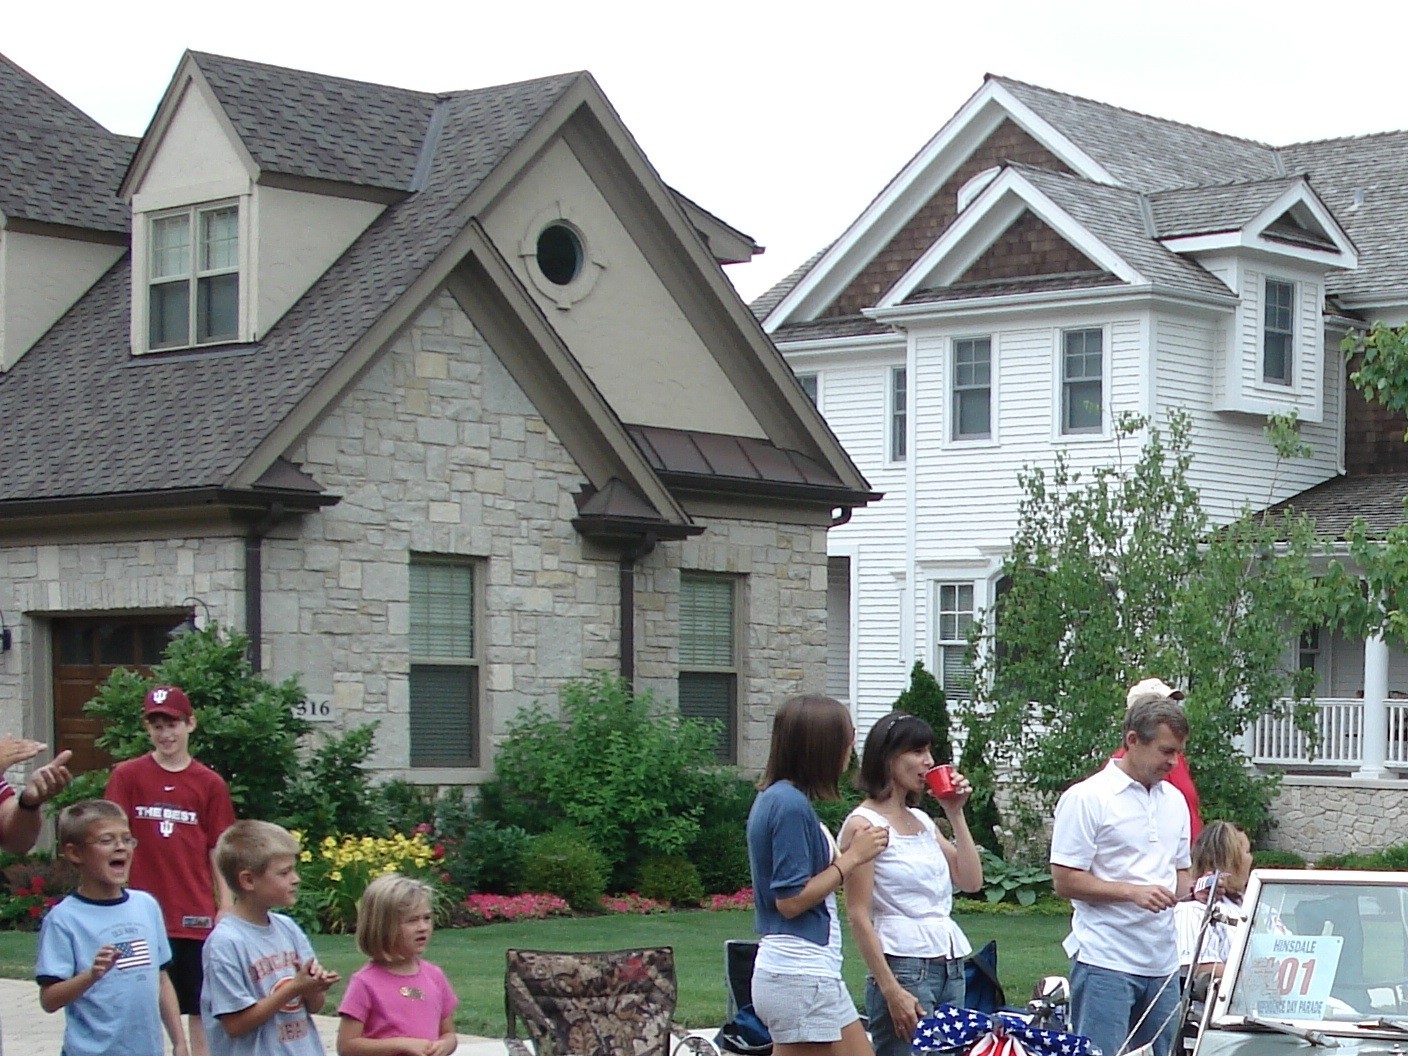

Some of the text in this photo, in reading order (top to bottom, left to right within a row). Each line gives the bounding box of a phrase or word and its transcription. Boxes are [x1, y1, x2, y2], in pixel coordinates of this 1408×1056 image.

[296, 700, 330, 717] 316
[135, 805, 163, 818] THE
[1273, 939, 1317, 953] HINSDALE
[1298, 1001, 1322, 1014] PARADE
